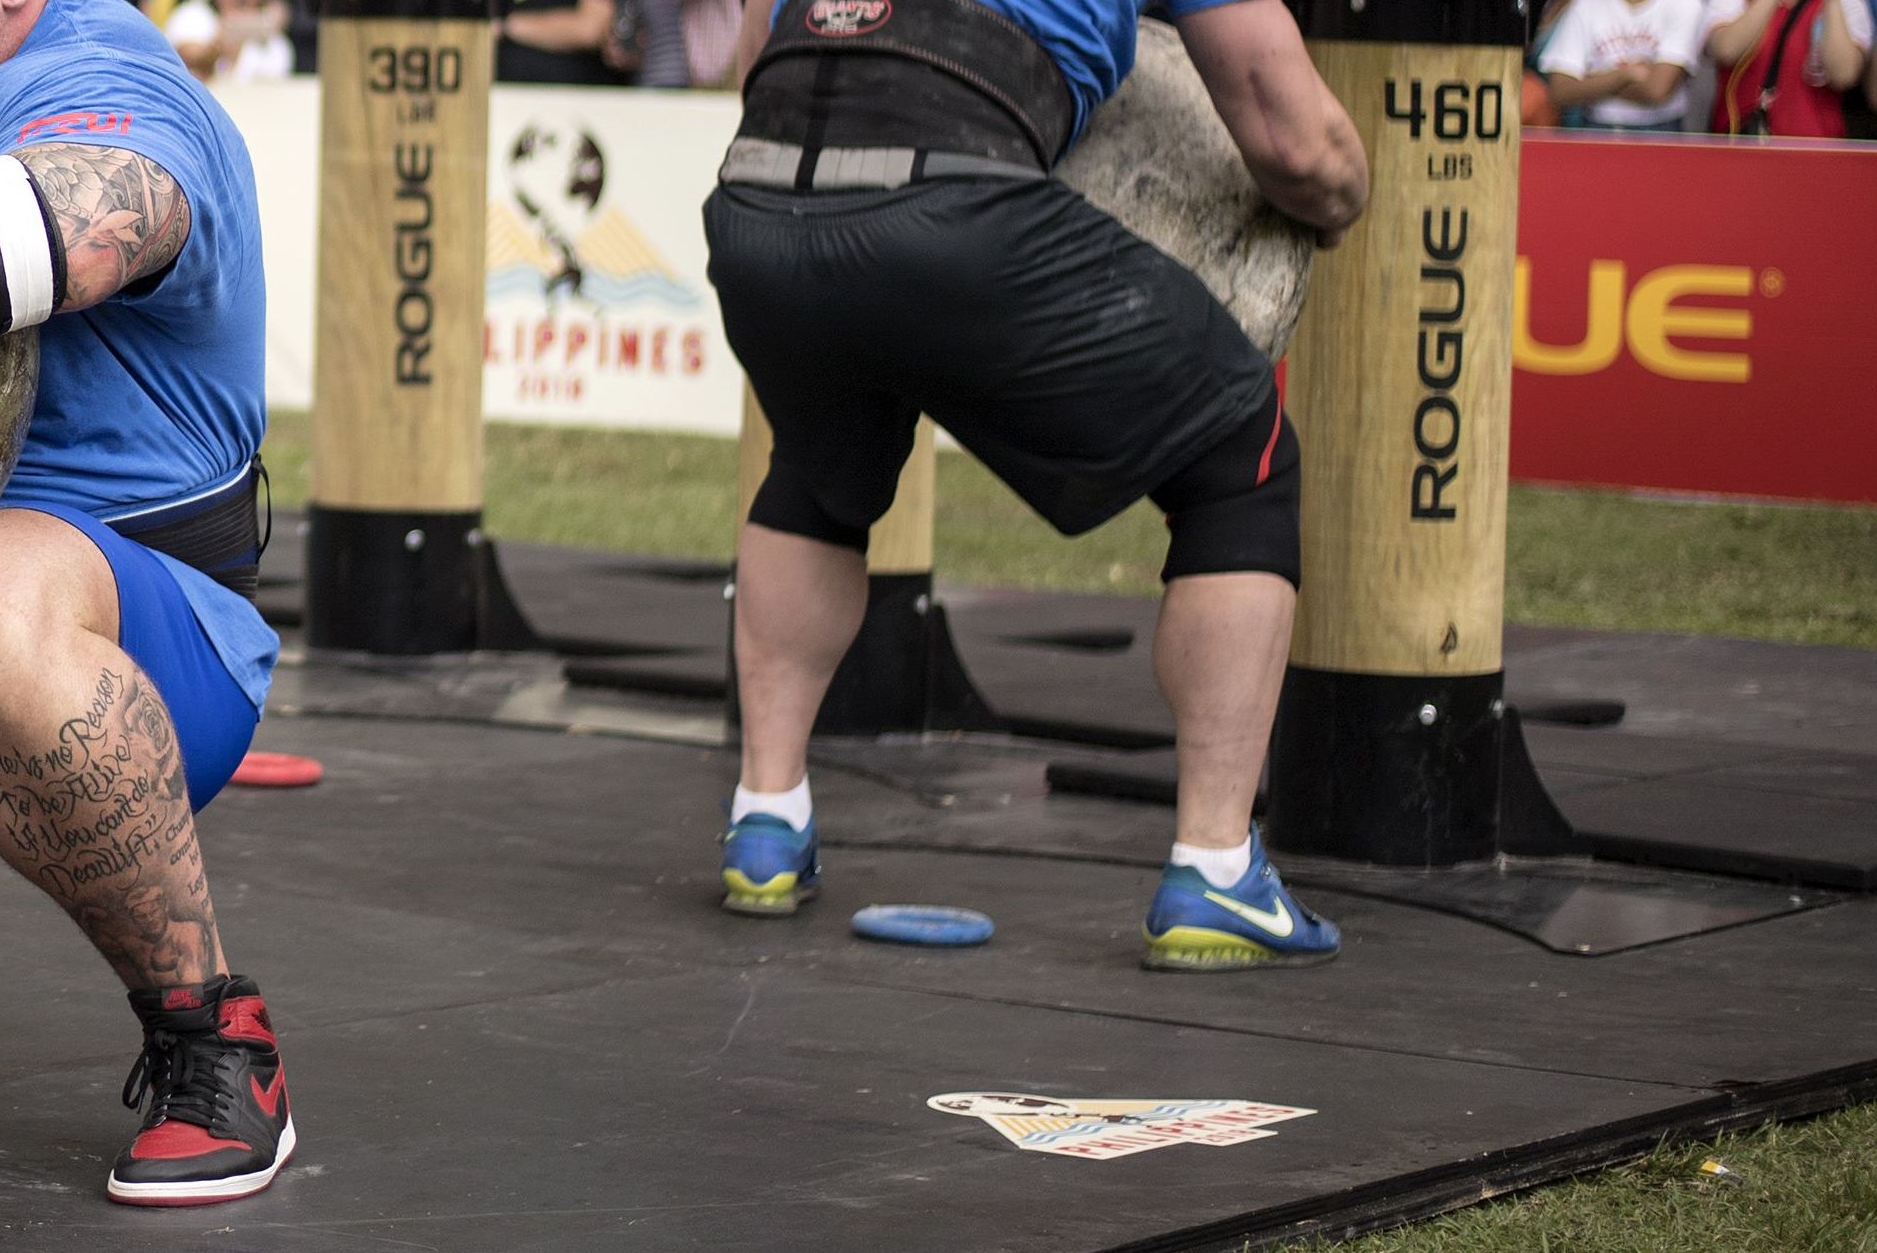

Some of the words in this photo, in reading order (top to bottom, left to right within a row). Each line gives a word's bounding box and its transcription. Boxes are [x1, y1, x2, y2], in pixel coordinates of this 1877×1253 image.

[369, 47, 462, 94] 390
[1384, 78, 1502, 142] 460
[1427, 154, 1473, 180] LBS
[394, 143, 434, 388] ROGUE
[483, 320, 707, 376] LIPPINES
[1512, 255, 1755, 383] UE
[1410, 205, 1467, 523] ROGUE
[59, 667, 124, 770] Reason
